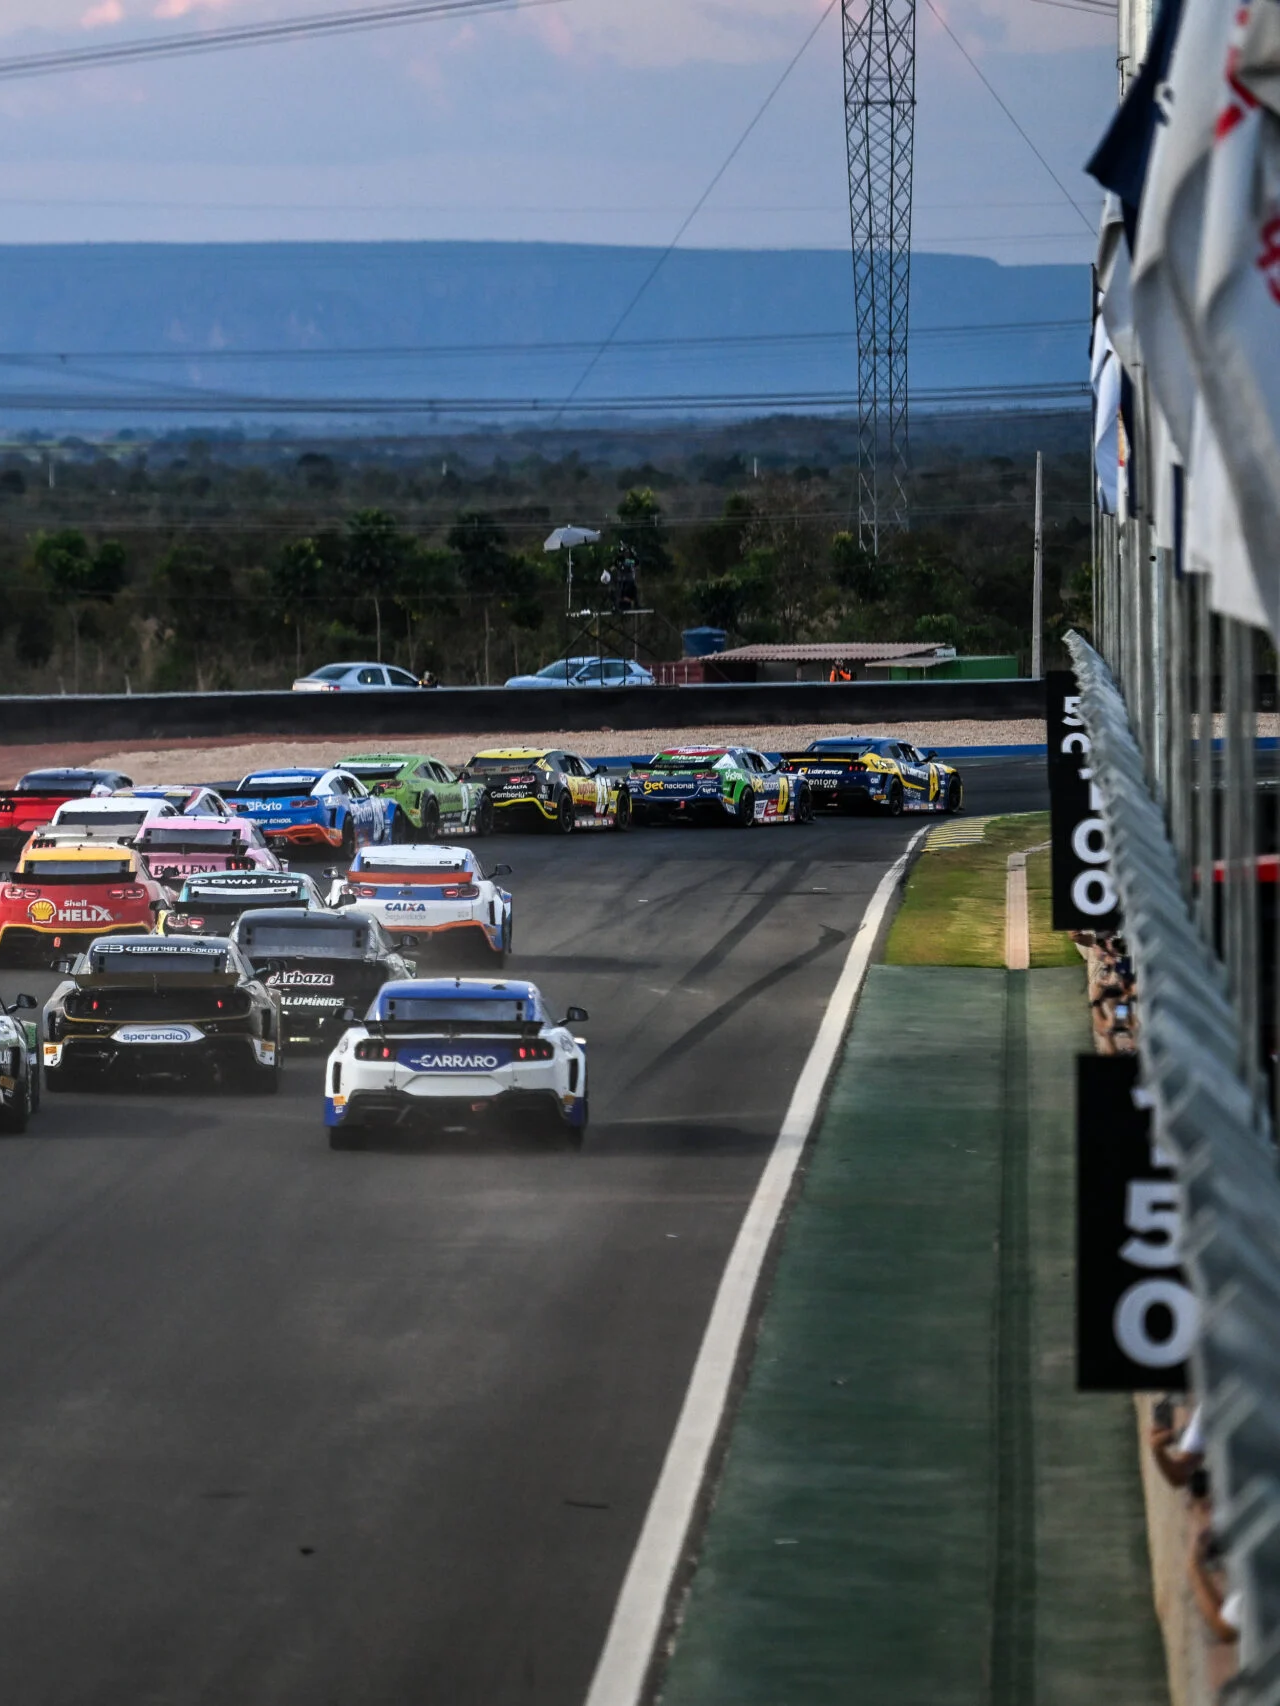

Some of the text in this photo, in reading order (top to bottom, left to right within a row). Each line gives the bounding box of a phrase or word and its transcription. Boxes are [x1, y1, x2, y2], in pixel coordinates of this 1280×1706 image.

[255, 802, 282, 812] Porto
[154, 865, 217, 876] BLENA
[58, 905, 114, 921] HELIX
[385, 903, 426, 912] CAIXA
[265, 971, 334, 986] Arbaza
[123, 1032, 183, 1042] sperandio
[421, 1055, 498, 1067] CARRARO
